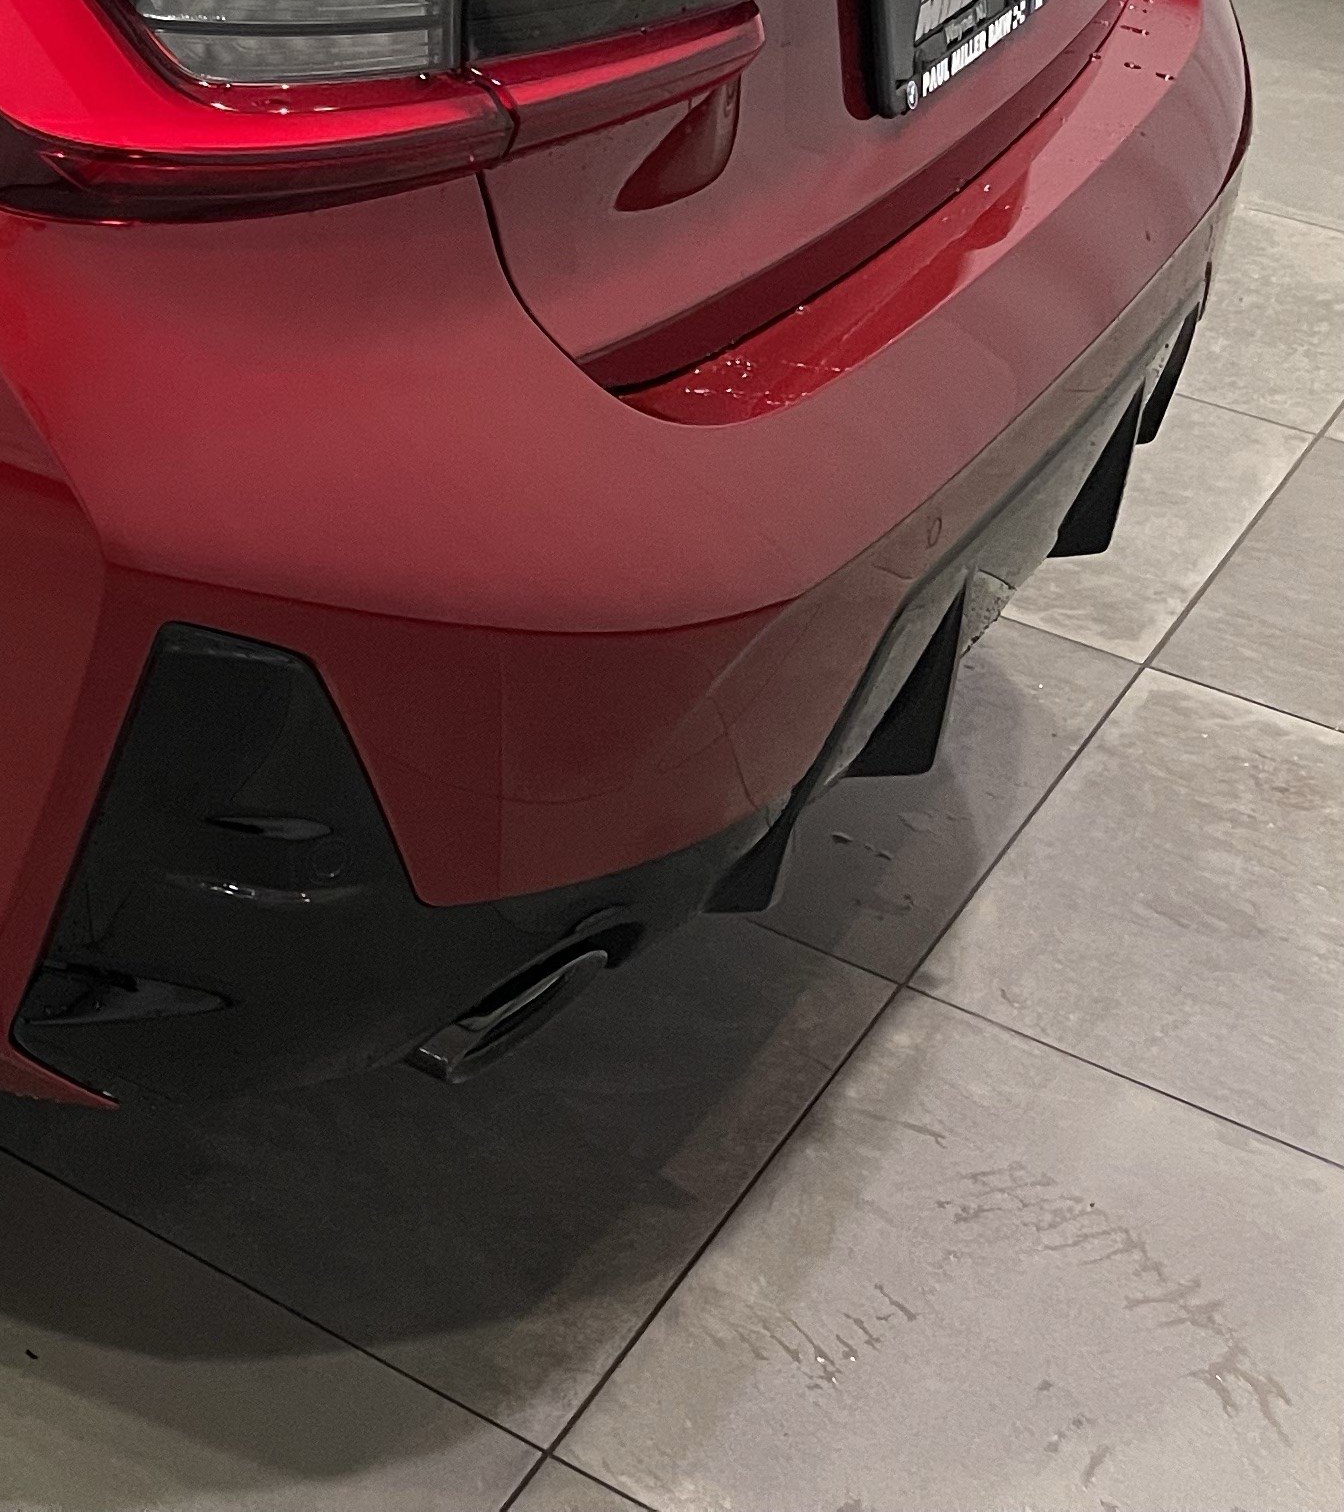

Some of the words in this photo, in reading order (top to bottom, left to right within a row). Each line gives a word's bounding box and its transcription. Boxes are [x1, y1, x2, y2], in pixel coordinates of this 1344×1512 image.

[922, 57, 950, 98] PAUL
[951, 30, 987, 76] MILLER
[988, 9, 1012, 48] BMW
